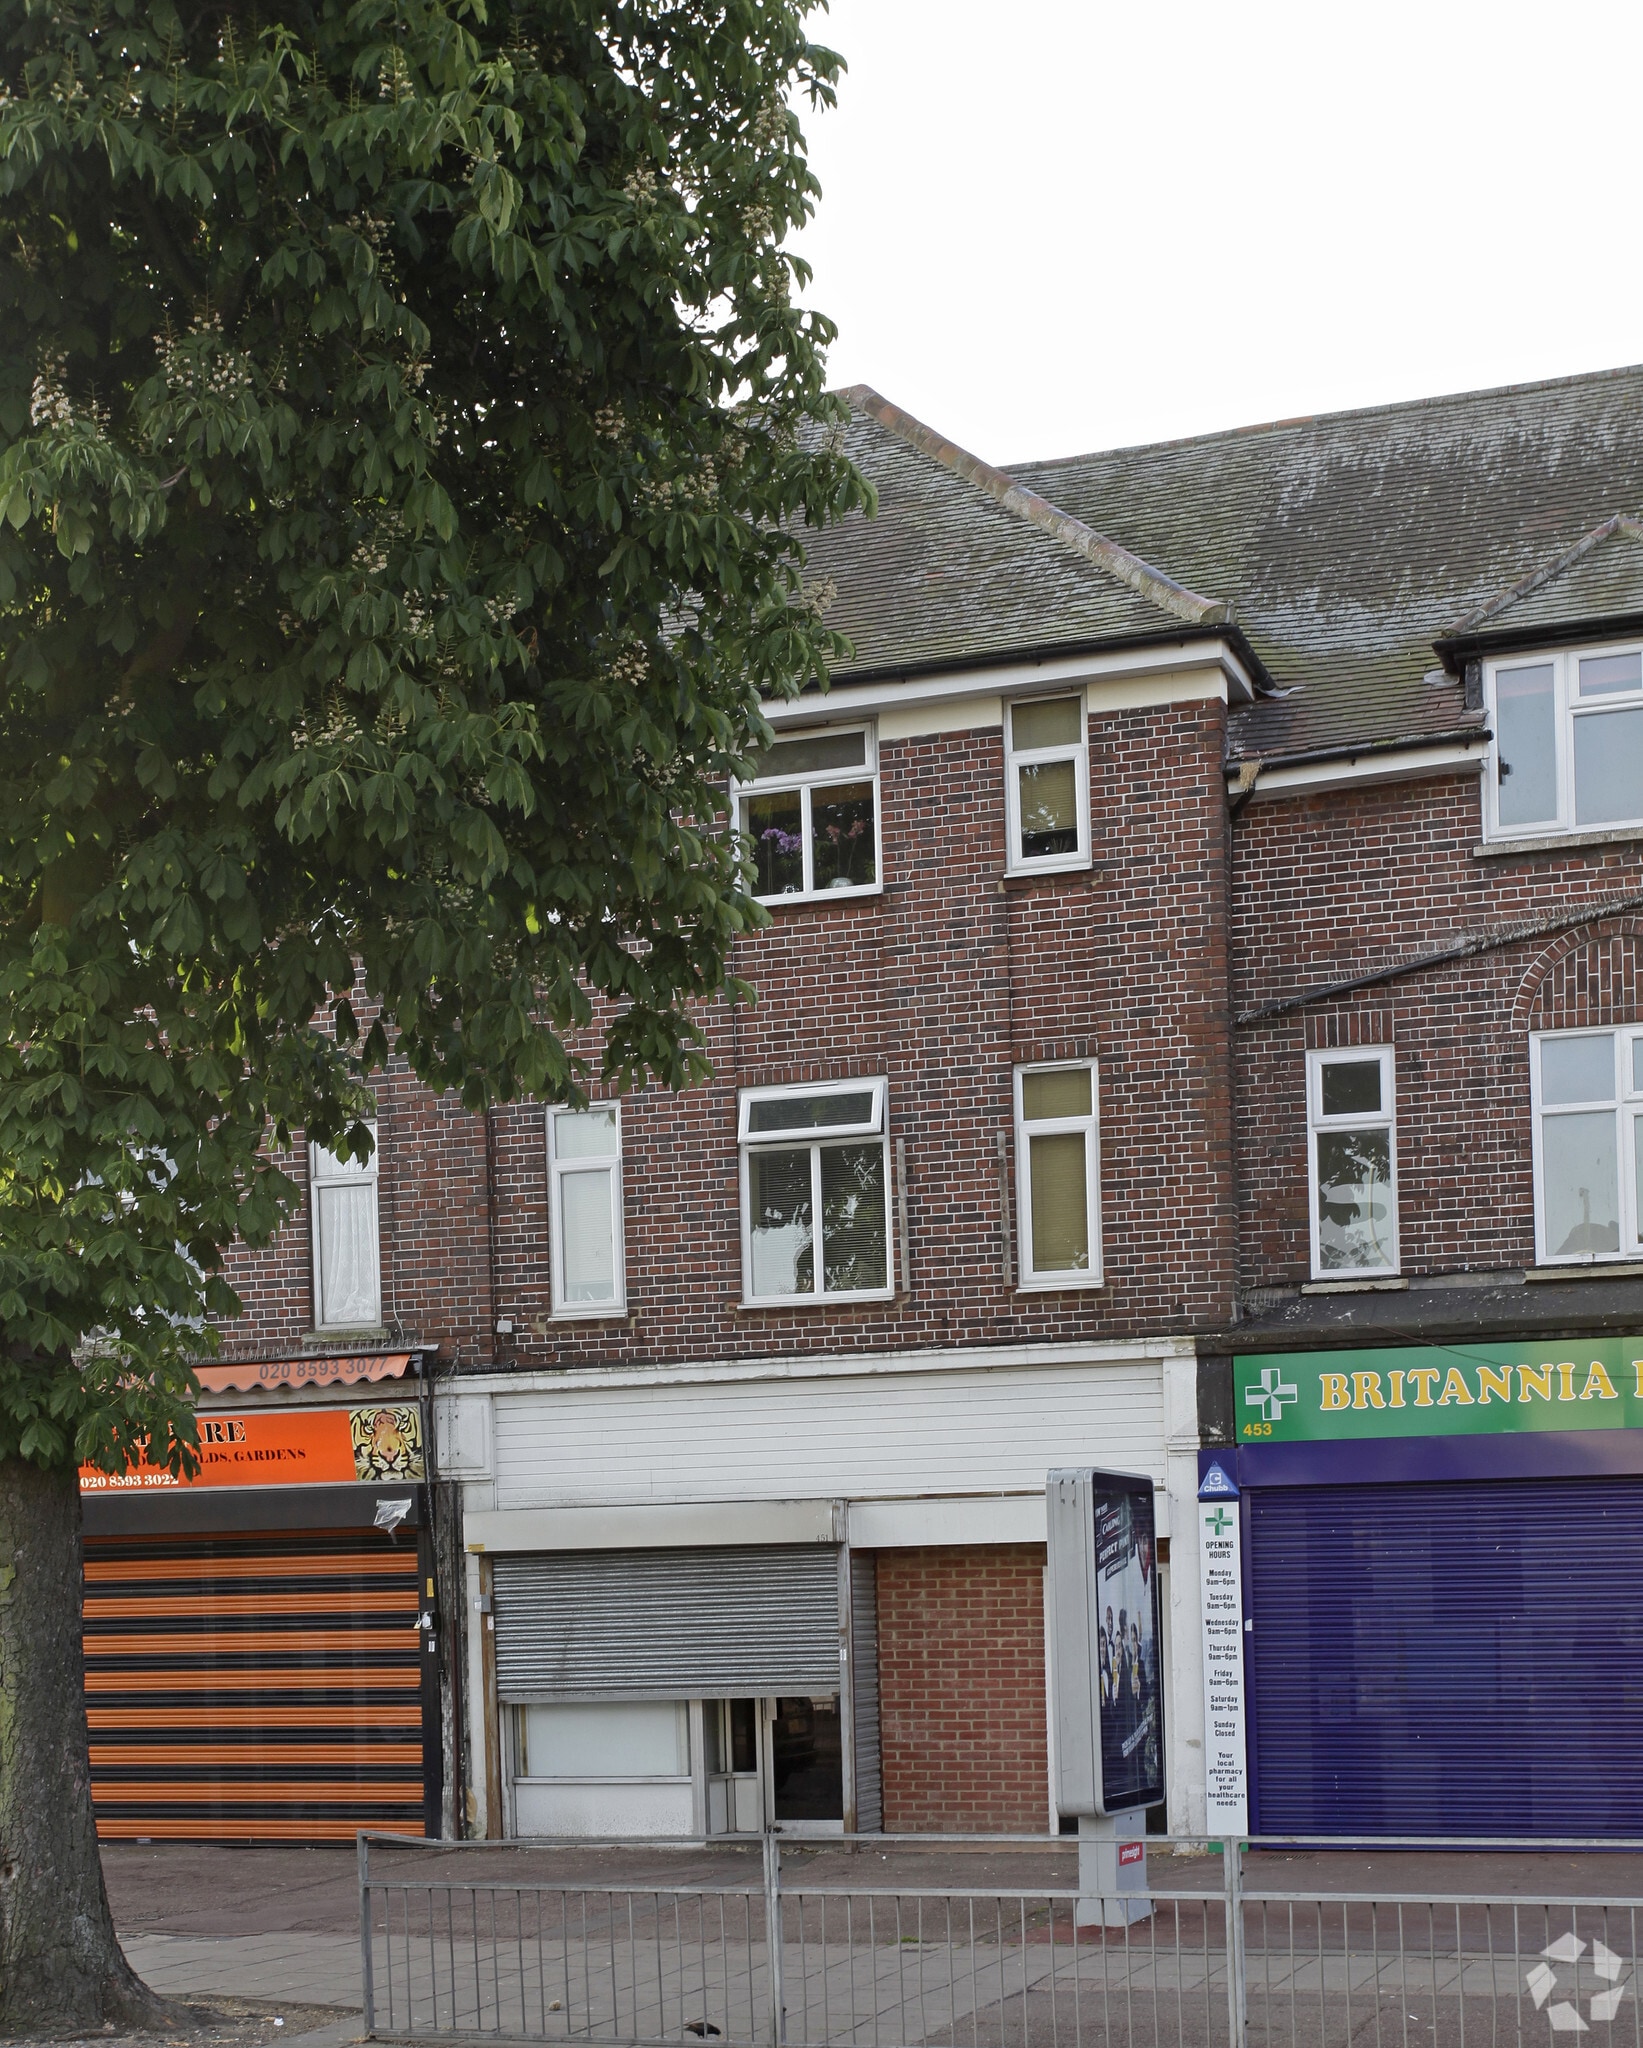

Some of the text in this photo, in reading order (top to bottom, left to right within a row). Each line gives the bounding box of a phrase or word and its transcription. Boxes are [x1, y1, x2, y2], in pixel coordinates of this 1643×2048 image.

[260, 1356, 388, 1380] 020 8593 3077
[1318, 1360, 1619, 1411] BRITANNIA
[1243, 1423, 1272, 1436] 453
[234, 1448, 306, 1463] GARDENS
[80, 1473, 179, 1489] 020 8593 3022
[1203, 1484, 1229, 1493] Chubb
[1205, 1540, 1234, 1549] OPENING
[1208, 1550, 1231, 1559] HOURS
[1208, 1569, 1232, 1577] Monday
[1209, 1593, 1234, 1601] Tuesday
[1205, 1619, 1239, 1627] Wednesday
[1209, 1644, 1237, 1652] Thursday
[1213, 1669, 1233, 1678] Friday
[1210, 1695, 1238, 1703] Saturday
[1213, 1720, 1236, 1729] Sunday
[1214, 1729, 1236, 1737] Closed
[1218, 1751, 1233, 1759] Your
[1209, 1768, 1243, 1776] pharmacy
[1218, 1784, 1234, 1792] your
[1208, 1791, 1246, 1799] healthcare
[1216, 1799, 1237, 1807] needs
